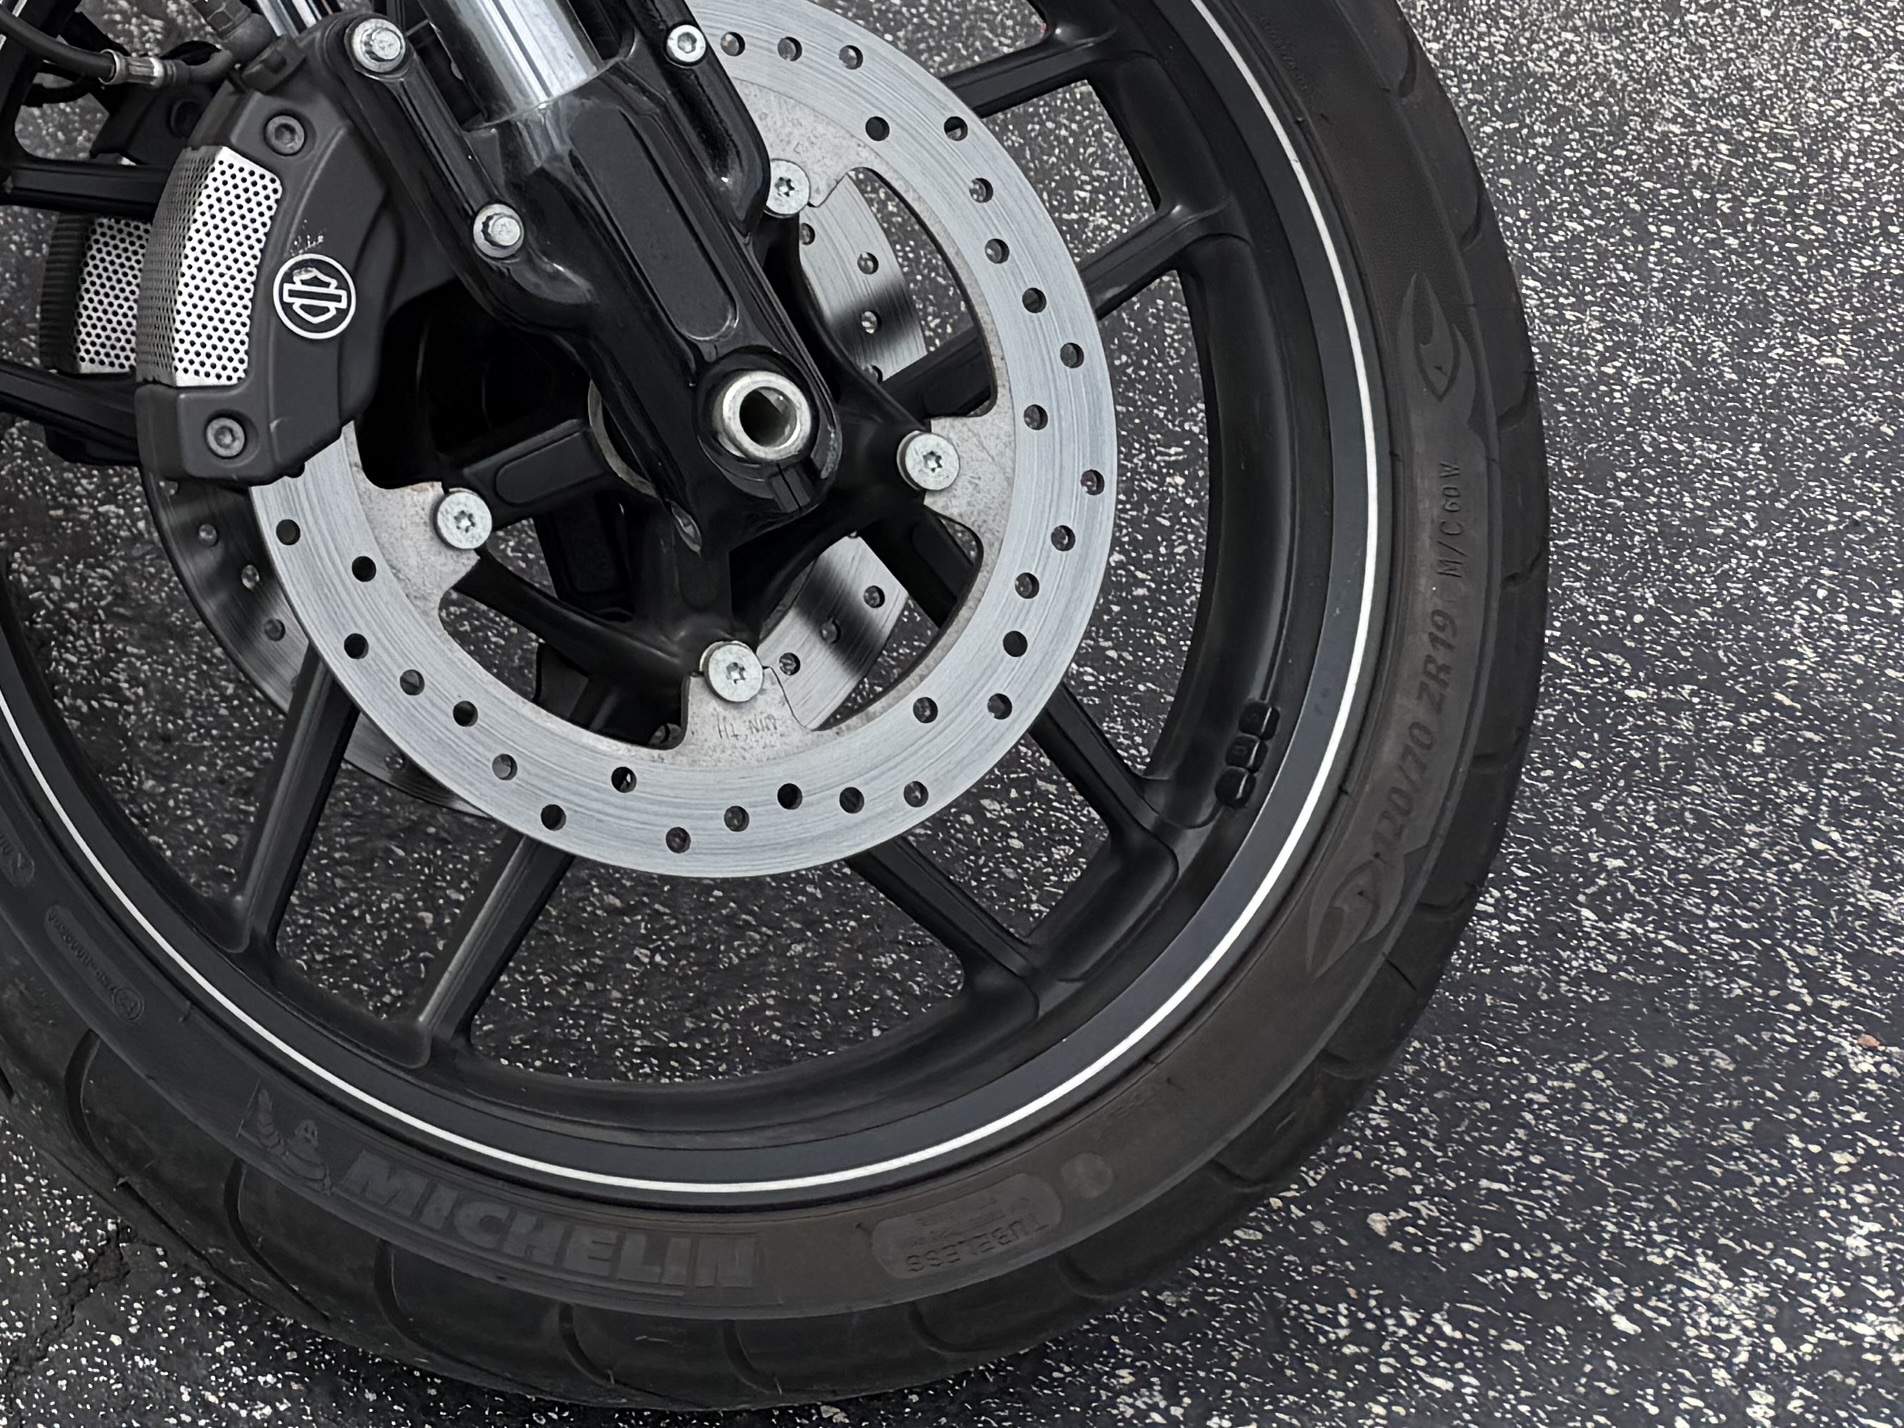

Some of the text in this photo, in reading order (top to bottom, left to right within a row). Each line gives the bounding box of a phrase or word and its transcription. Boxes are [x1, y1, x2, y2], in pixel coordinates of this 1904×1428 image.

[1436, 520, 1466, 577] M/C
[1416, 608, 1458, 713] ZR19
[1375, 720, 1432, 850] 120/70
[339, 1149, 757, 1289] MICHELIN
[906, 1215, 1049, 1273] TUBELESS
